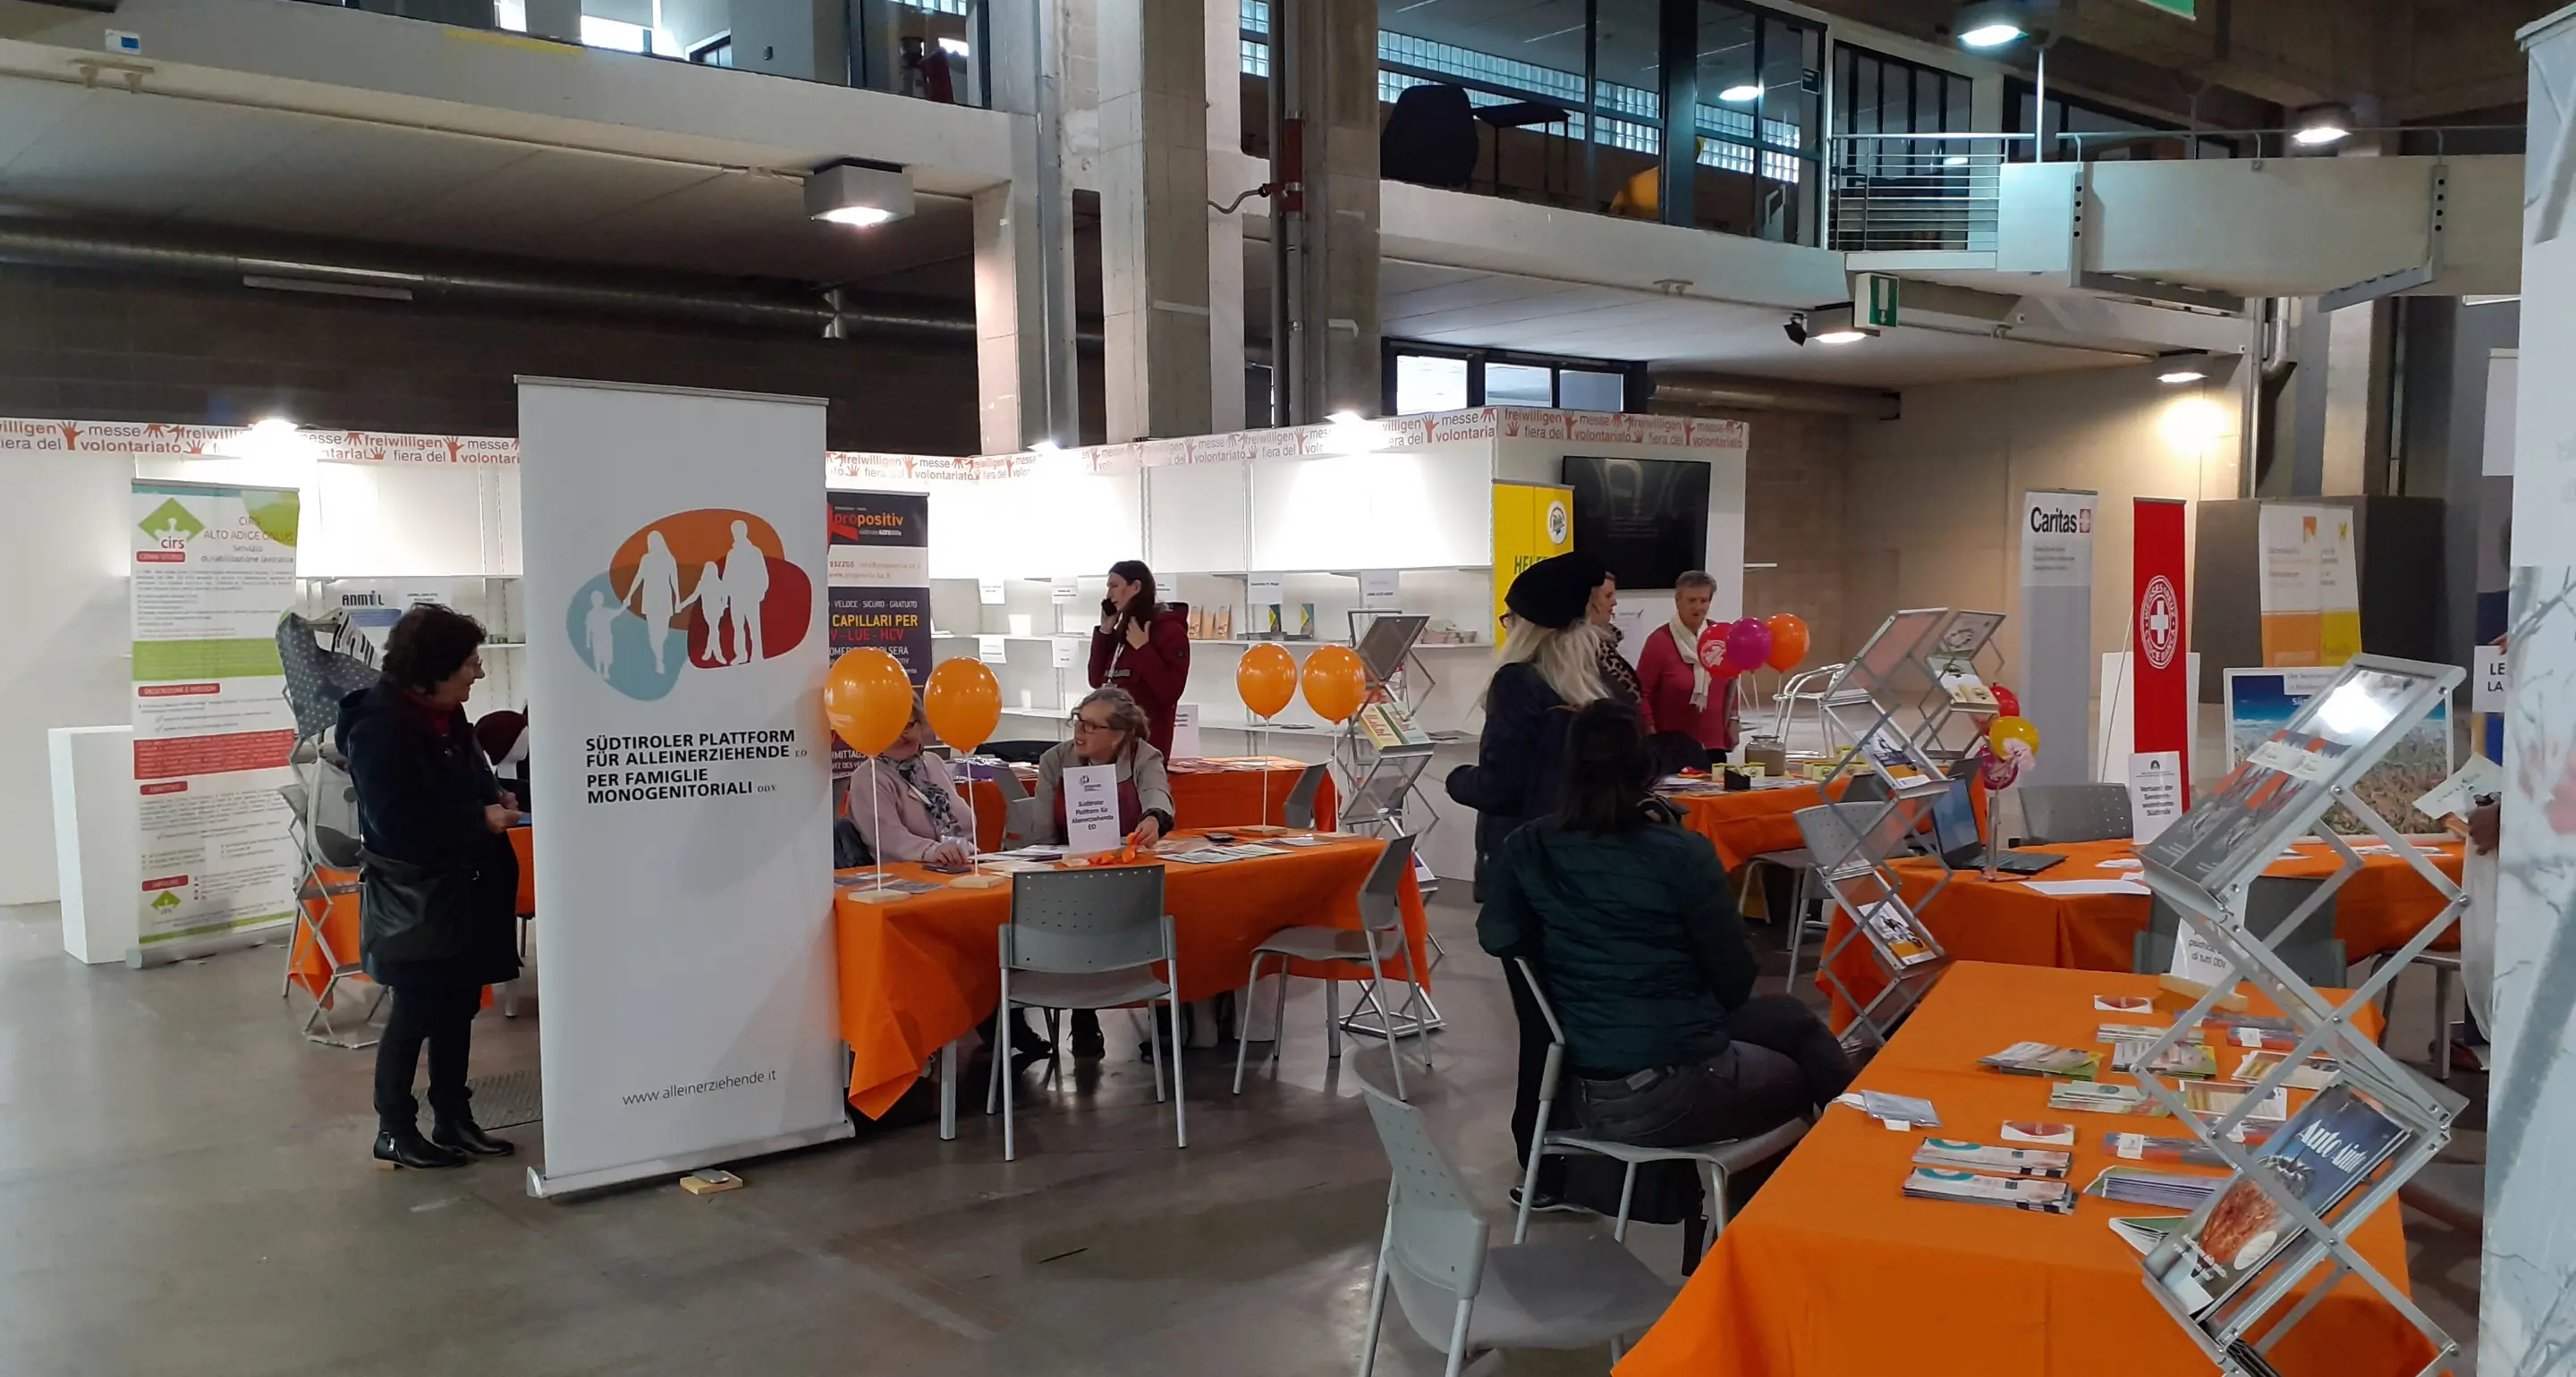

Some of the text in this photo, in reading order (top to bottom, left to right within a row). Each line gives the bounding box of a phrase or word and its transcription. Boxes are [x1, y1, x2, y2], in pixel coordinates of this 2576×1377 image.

[1442, 413, 1479, 426] messe
[1580, 415, 1611, 426] messe
[1697, 423, 1725, 433] messe
[89, 426, 141, 436] messe
[1525, 426, 1546, 437] fiera
[1549, 427, 1563, 440] del
[1575, 429, 1631, 442] volontariato
[365, 435, 442, 449] freiwilligen
[468, 440, 509, 450] messe
[1199, 440, 1224, 448] messe
[1408, 432, 1423, 445] del
[37, 438, 61, 451] del
[80, 440, 182, 453] volontariato
[1262, 447, 1280, 458] fiera
[1283, 444, 1295, 456] del
[394, 450, 423, 461] fiera
[427, 451, 446, 462] del
[1195, 450, 1245, 462] volontariato
[919, 459, 950, 469] messe
[915, 471, 973, 481] volontariato
[2030, 507, 2077, 533] Caritas
[204, 530, 229, 540] ALTO
[161, 536, 184, 549] cirs
[832, 614, 919, 627] CAPILLARI PER
[848, 629, 870, 641] LUE
[880, 629, 904, 640] HCV
[586, 730, 795, 752] SÜDTIROLER PLATTFORM
[587, 752, 619, 767] FÜR
[626, 746, 790, 765] ALLEINERZIEHENDE
[588, 769, 708, 788] PER FAMIGLIE
[588, 781, 776, 804] MONOGENITORIALI ODV
[623, 1069, 776, 1105] www.alleinerziehende.it
[2295, 1119, 2342, 1157] Auto
